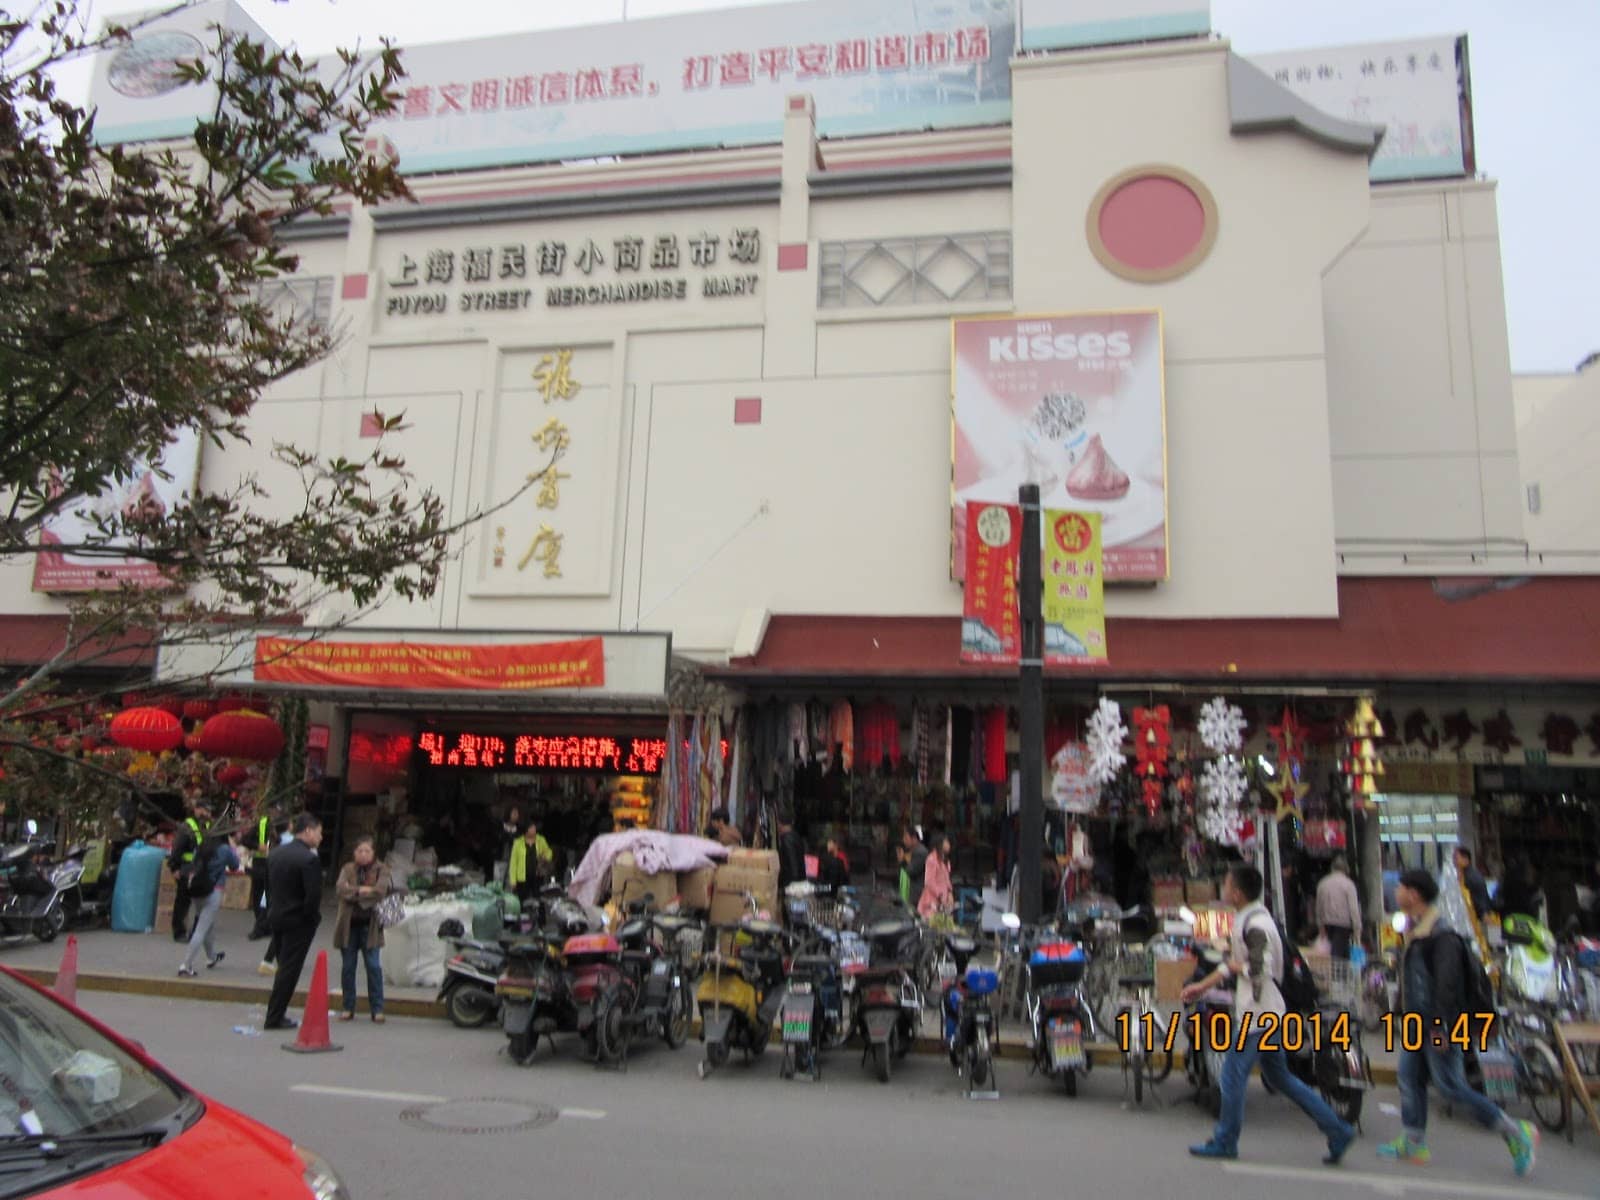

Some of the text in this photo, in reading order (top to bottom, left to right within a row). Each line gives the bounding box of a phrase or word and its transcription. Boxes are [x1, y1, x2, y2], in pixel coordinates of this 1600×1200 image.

[385, 25, 990, 118] 善文明诚信体系，打造平安和谐市场
[387, 226, 761, 288] 上海福民街小商品市场
[386, 274, 760, 316] FUYOU STREET MERCHANDISE MART
